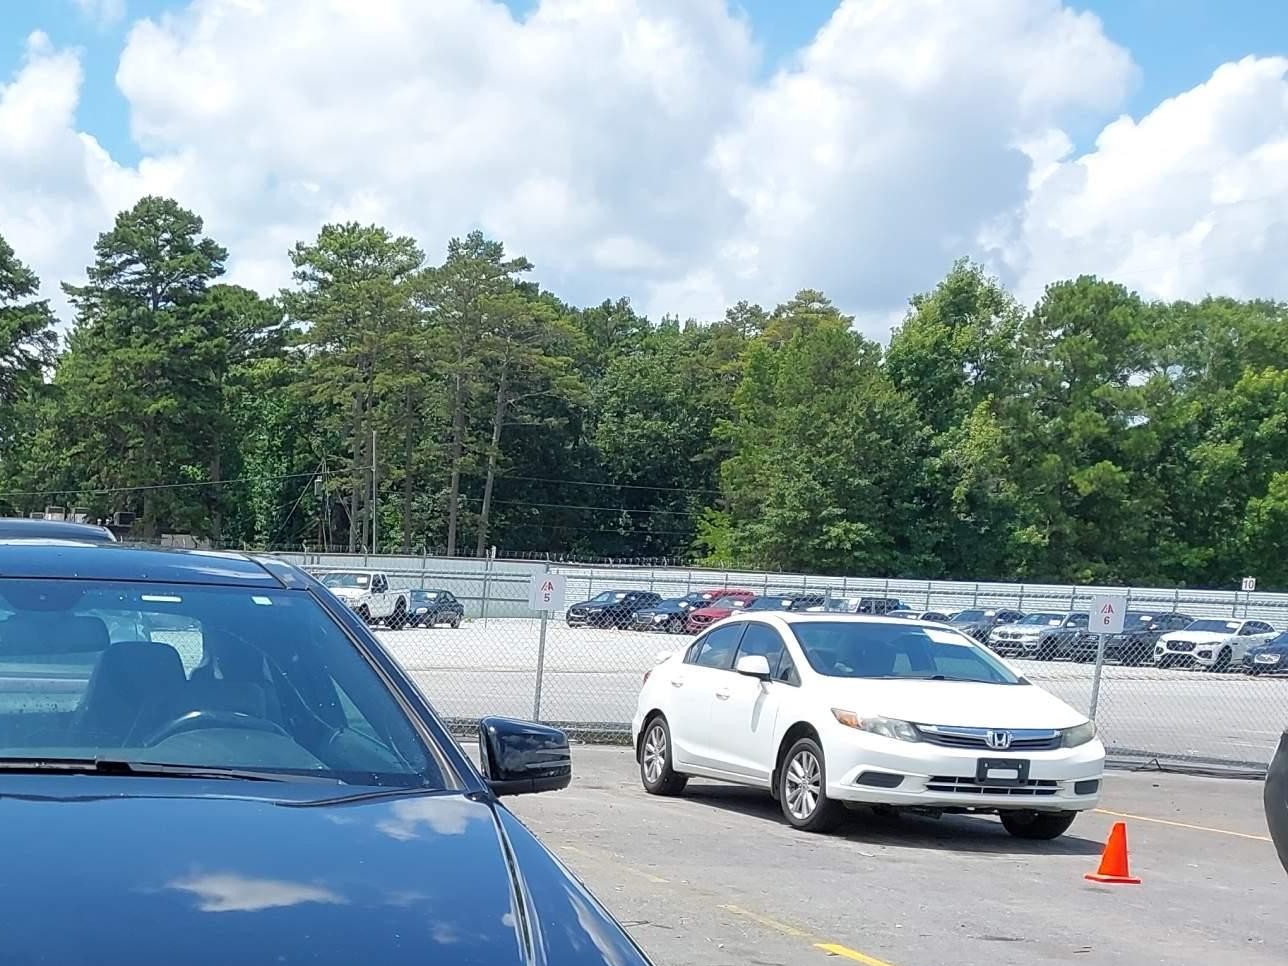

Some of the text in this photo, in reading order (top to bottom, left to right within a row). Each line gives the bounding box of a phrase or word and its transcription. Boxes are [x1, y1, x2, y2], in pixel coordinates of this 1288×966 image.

[1243, 580, 1255, 590] 10
[544, 593, 551, 603] 5
[1103, 616, 1110, 626] 6
